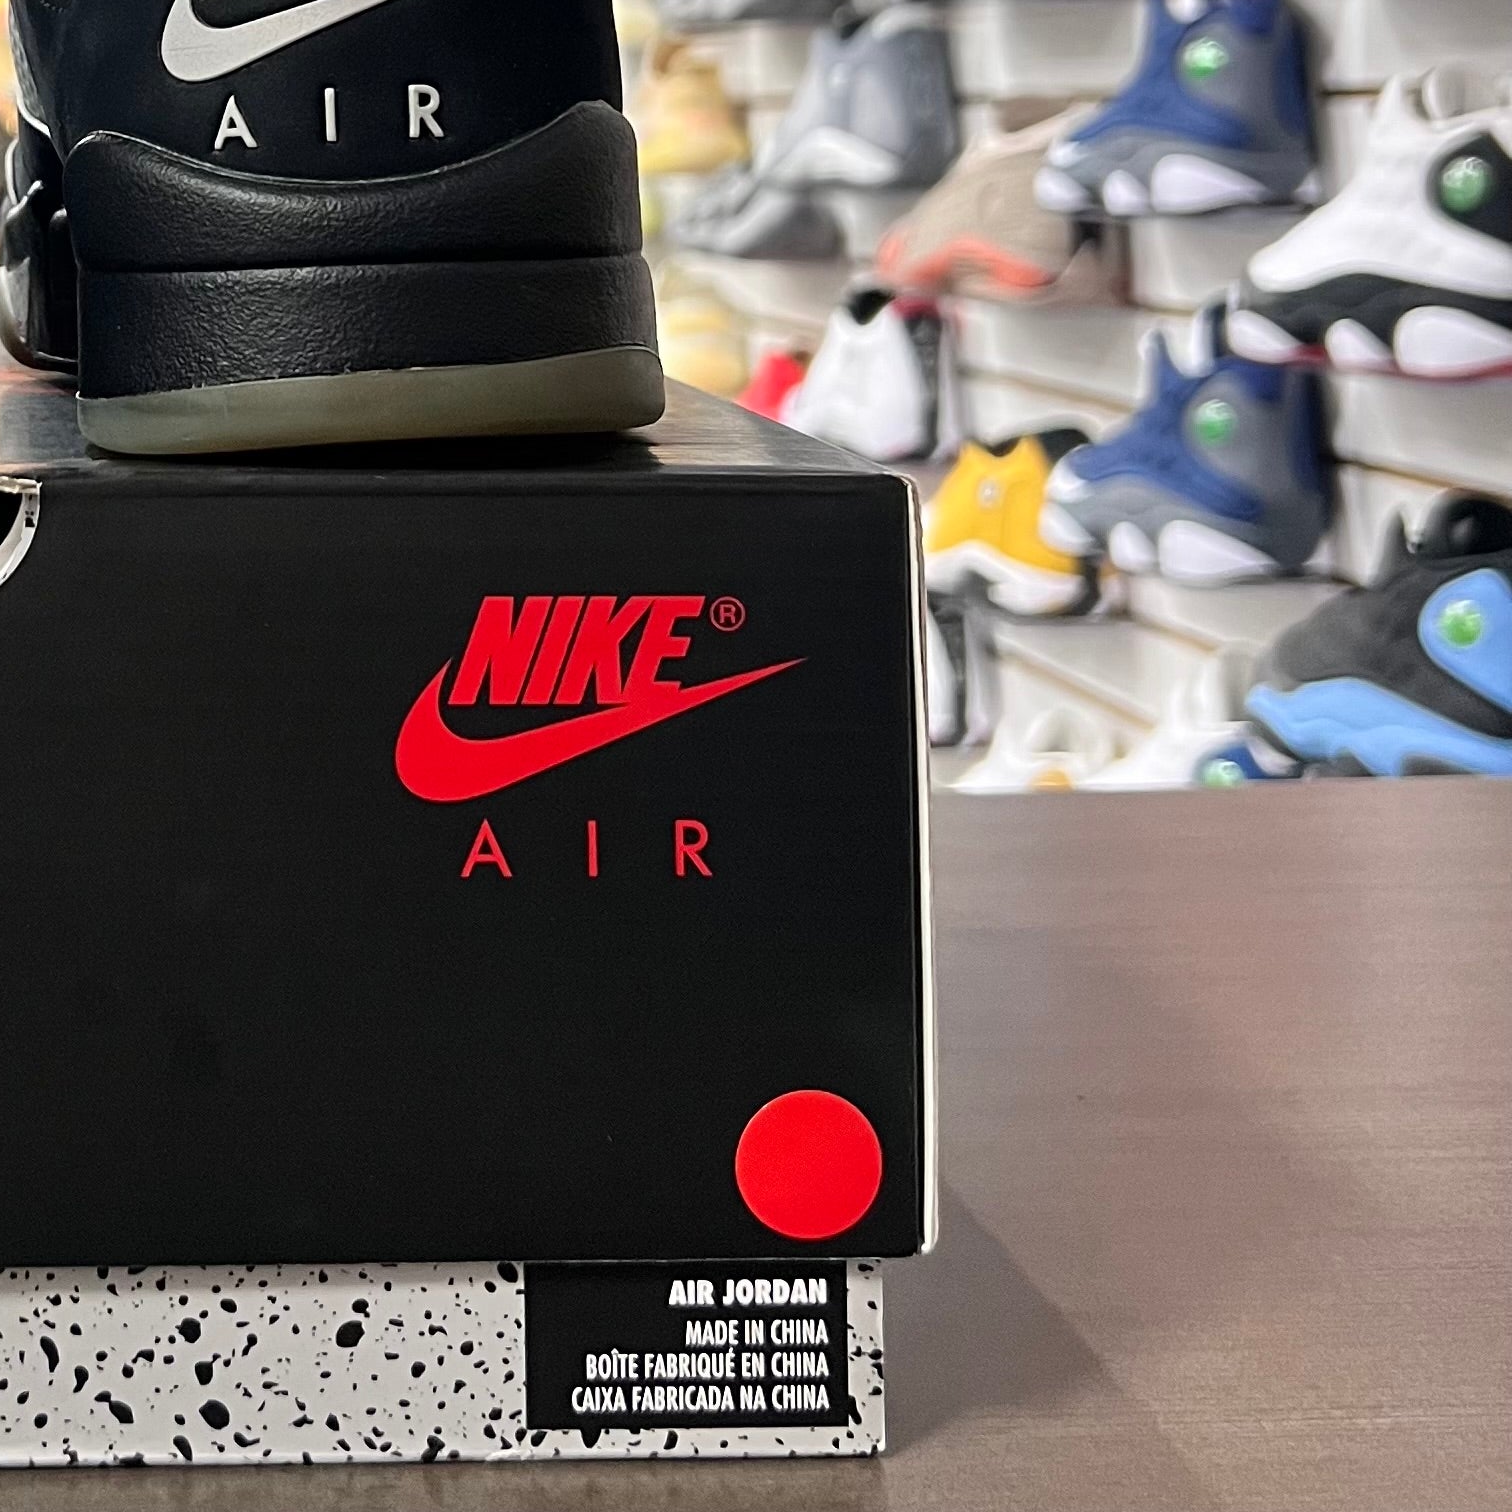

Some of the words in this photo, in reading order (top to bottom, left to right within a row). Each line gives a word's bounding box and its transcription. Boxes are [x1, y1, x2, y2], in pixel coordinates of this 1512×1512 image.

[214, 83, 445, 151] AIR
[448, 595, 706, 705] NIKE
[460, 818, 713, 878] AIR
[668, 1279, 715, 1306] AIR
[722, 1278, 828, 1305] JORDAN
[685, 1320, 740, 1345] MADE
[744, 1320, 765, 1345] IN
[771, 1319, 829, 1345] CHINA
[586, 1348, 639, 1380] BOÎTE
[644, 1347, 736, 1379] FABRIQUÉ
[742, 1352, 766, 1378] EN
[771, 1352, 829, 1378] CHINA
[572, 1386, 627, 1413] CAIXA
[632, 1385, 735, 1412] FABRICADA
[740, 1385, 767, 1411] NA
[771, 1384, 830, 1411] CHINA
